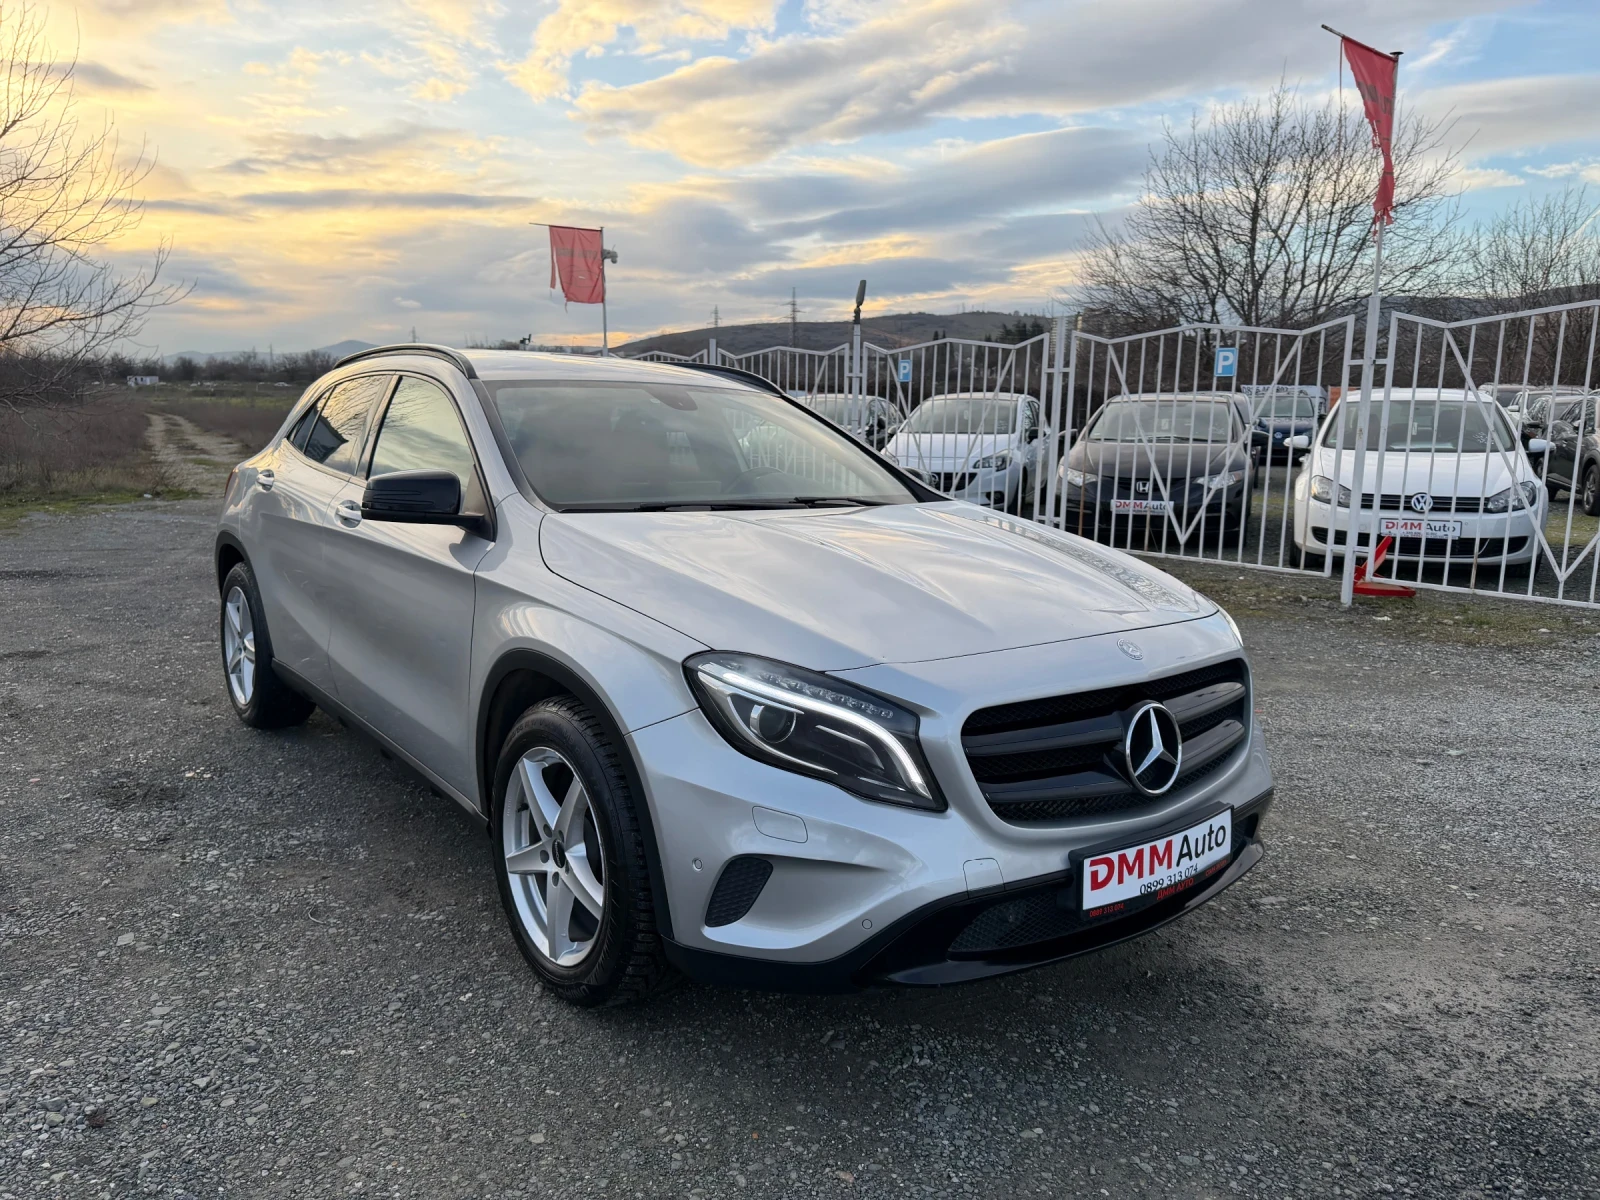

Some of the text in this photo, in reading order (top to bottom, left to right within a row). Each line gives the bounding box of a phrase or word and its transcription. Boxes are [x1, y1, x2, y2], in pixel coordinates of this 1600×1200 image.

[900, 362, 910, 380] P
[1217, 351, 1235, 374] P
[1139, 878, 1165, 896] 0899
[1166, 870, 1183, 886] 313
[1184, 863, 1199, 879] 074
